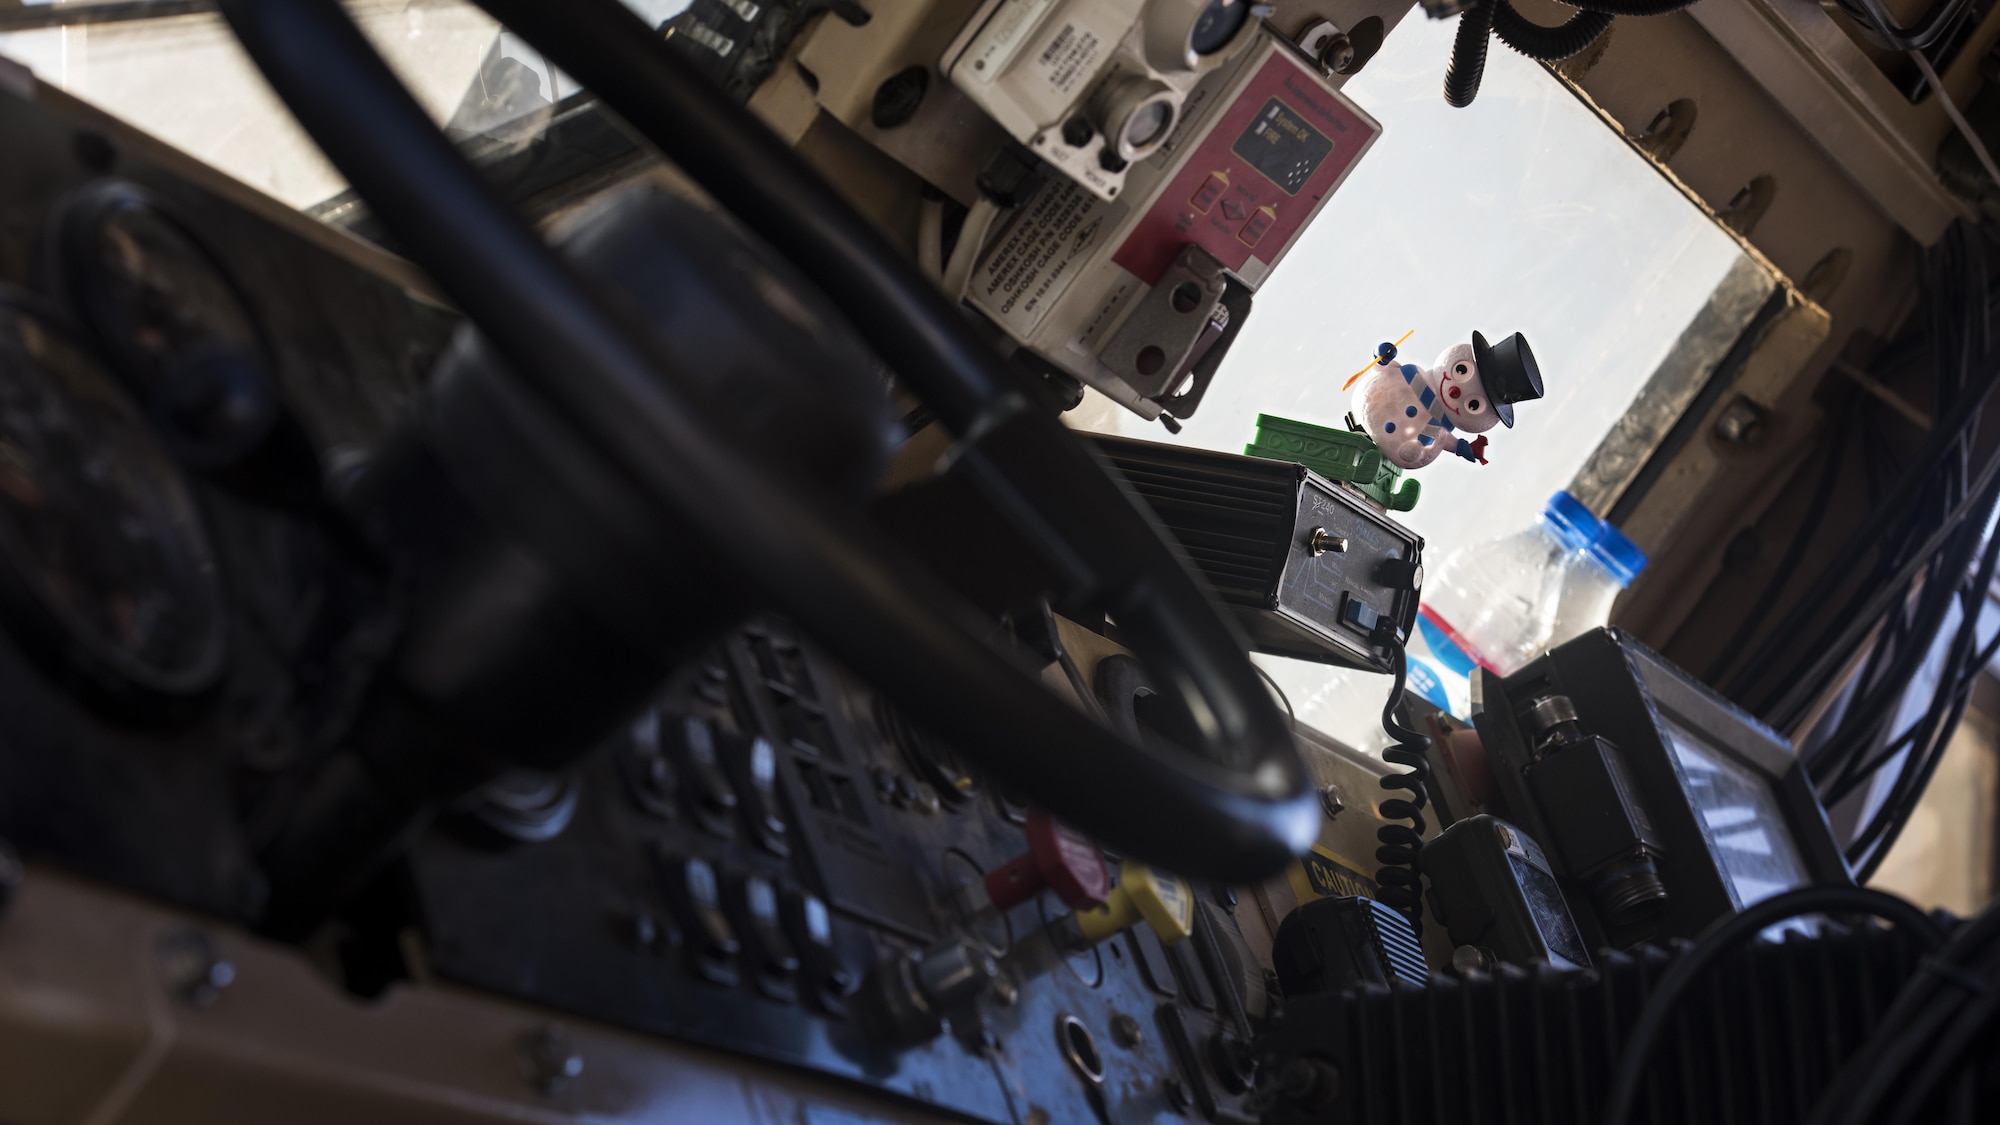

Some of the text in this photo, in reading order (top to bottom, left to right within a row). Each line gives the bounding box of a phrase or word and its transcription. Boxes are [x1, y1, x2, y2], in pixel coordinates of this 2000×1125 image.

[1262, 127, 1281, 146] FIRE
[1273, 112, 1311, 144] System OK
[985, 255, 1020, 296] AMEREX
[1016, 228, 1041, 257] CAGE
[1038, 201, 1062, 230] CODE
[986, 235, 1021, 276] AMEREX
[1017, 218, 1034, 237] P/N
[1000, 268, 1039, 315] OSHKOSH
[1036, 240, 1061, 269] CAGE
[1057, 212, 1083, 242] CODE
[1003, 245, 1042, 293] OSHKOSH
[1038, 228, 1056, 248] P/N
[1312, 861, 1374, 898] CAUTION
